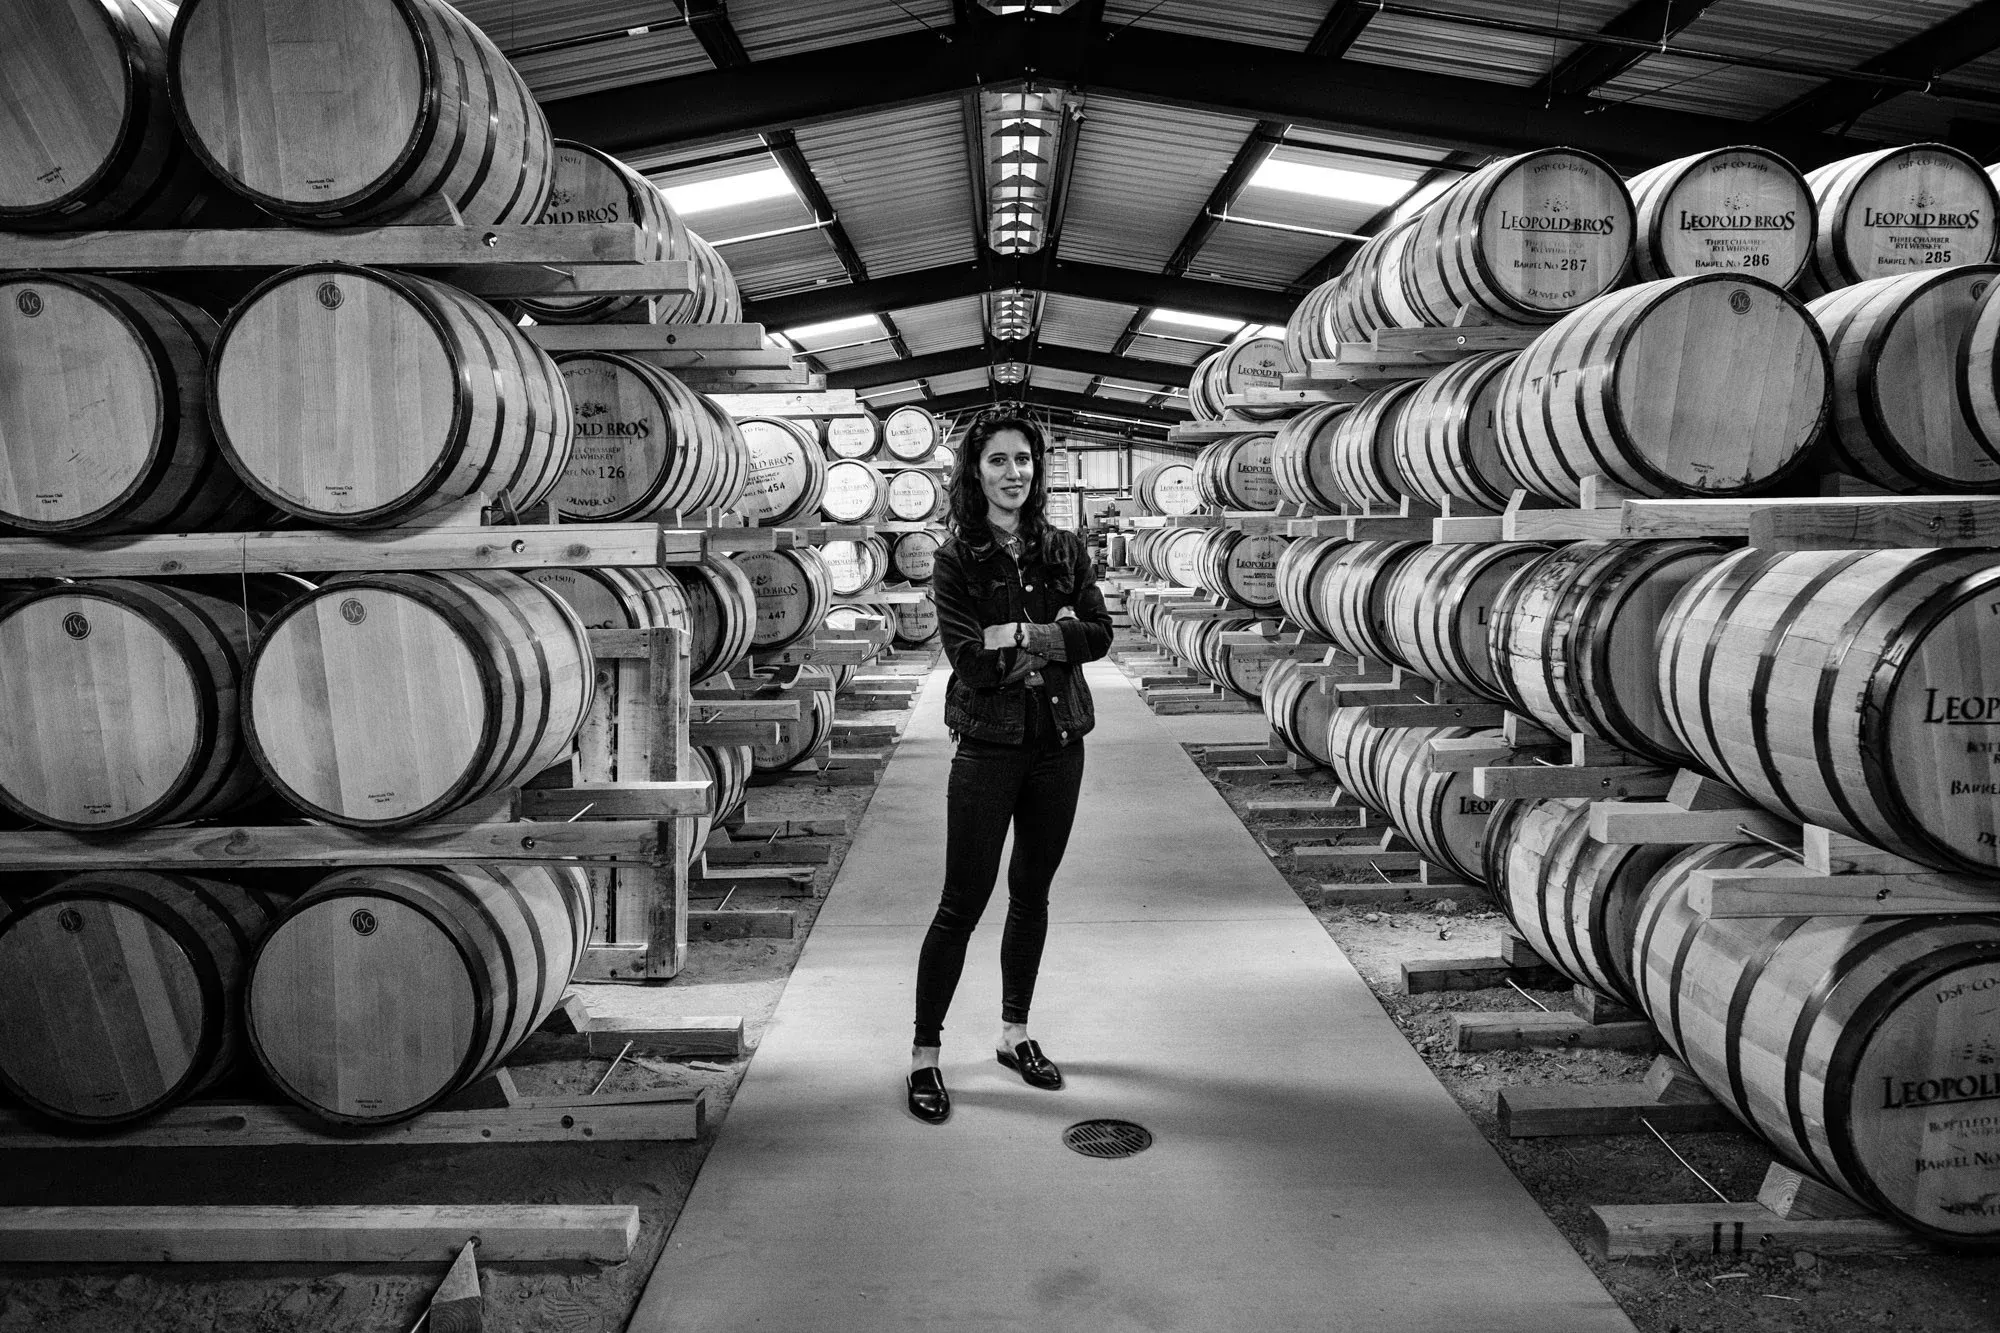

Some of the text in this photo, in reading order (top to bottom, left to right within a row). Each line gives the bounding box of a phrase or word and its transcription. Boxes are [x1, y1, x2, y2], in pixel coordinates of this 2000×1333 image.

[578, 202, 619, 224] BROS
[1864, 208, 1980, 229] LEOPOLD BROS
[1501, 211, 1614, 235] LEOPOLD BROS
[1680, 210, 1795, 231] LEOPOLD BROS
[1695, 260, 1724, 268] BARREL
[1743, 254, 1770, 267] 286
[1878, 256, 1906, 265] BARREL
[1925, 250, 1951, 264] 285
[1514, 260, 1541, 270] BARREL
[1561, 259, 1587, 271] 287
[1562, 290, 1576, 299] CO
[1238, 365, 1272, 377] LEOPOLD
[607, 417, 649, 439] BROS
[599, 466, 625, 479] 126
[1238, 463, 1272, 473] LEOPOLD
[768, 482, 785, 493] 454
[603, 496, 616, 505] CO
[1236, 559, 1270, 569] LEOPOLD
[772, 583, 798, 595] BROS
[768, 611, 785, 620] 447
[1915, 1156, 1969, 1173] BARREL
